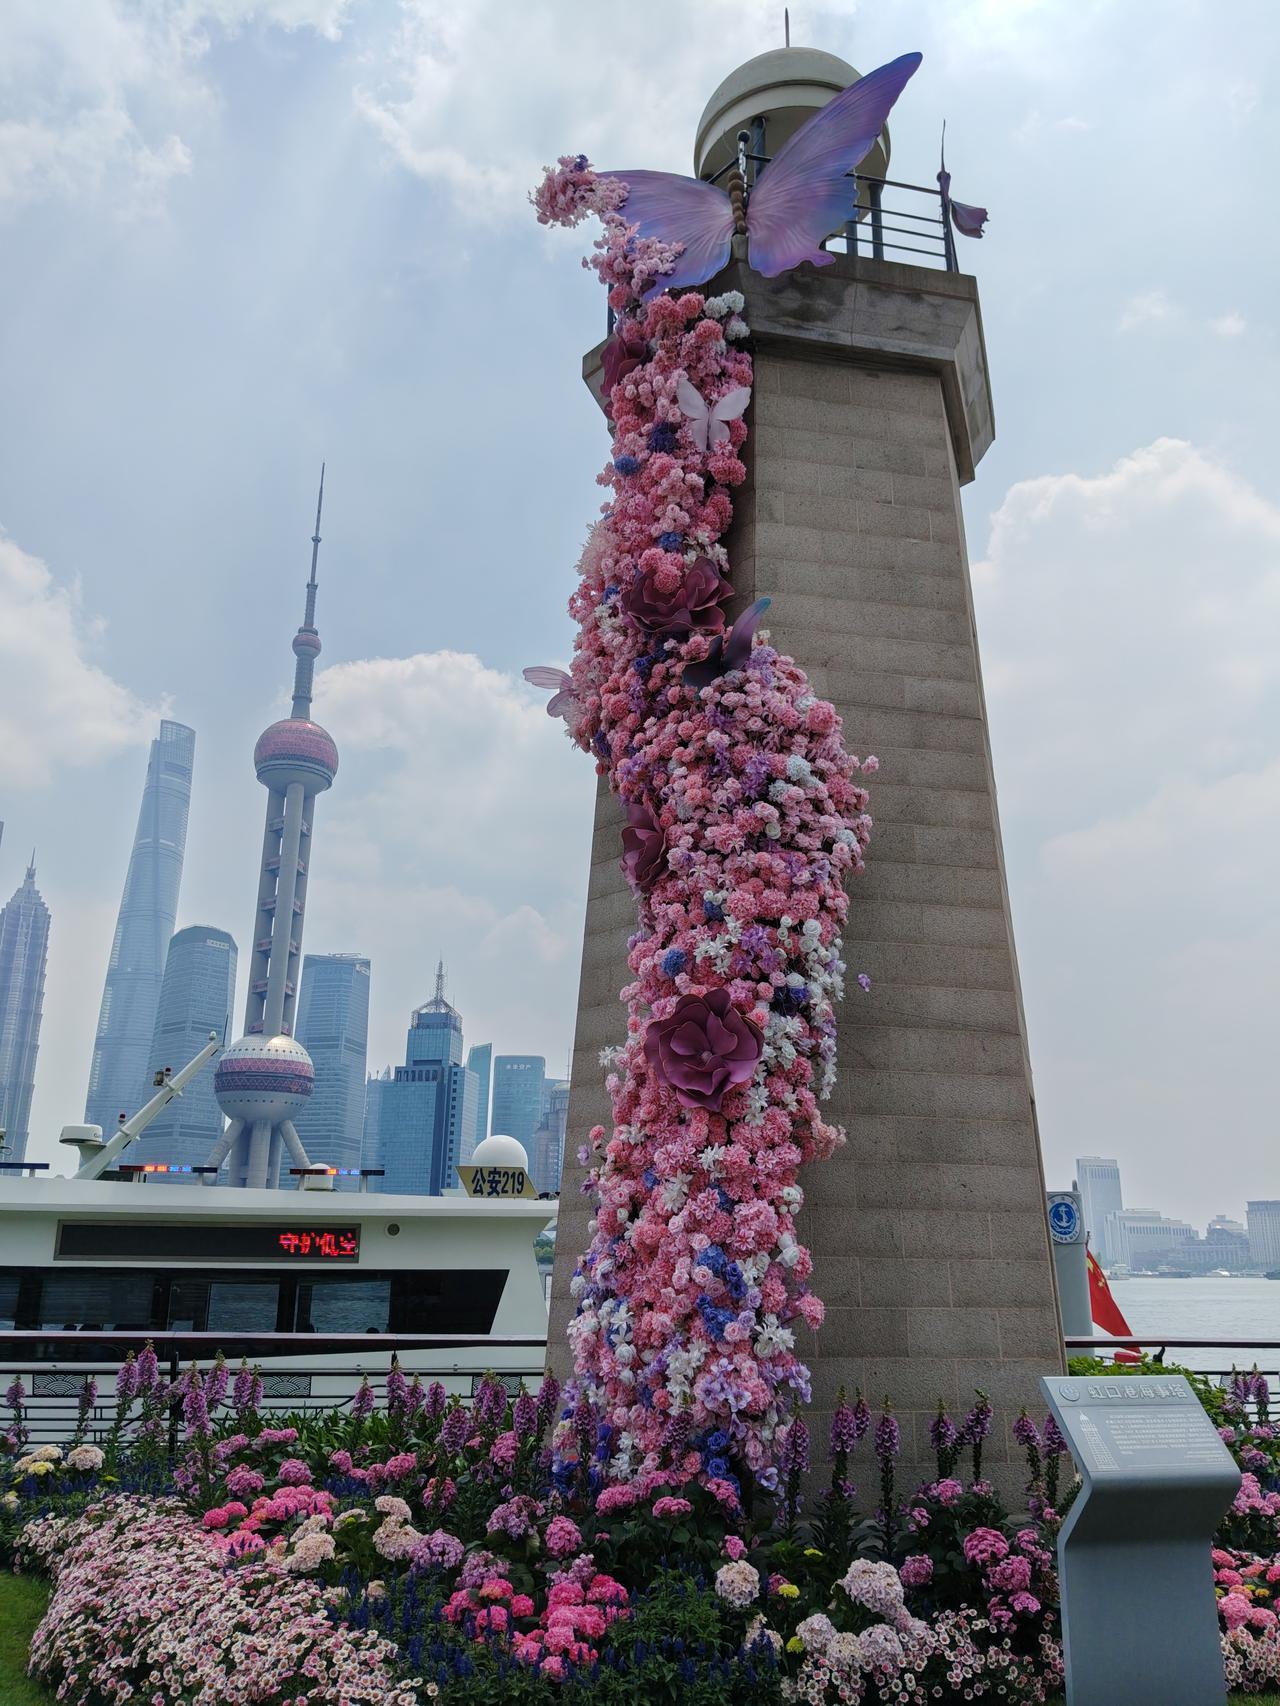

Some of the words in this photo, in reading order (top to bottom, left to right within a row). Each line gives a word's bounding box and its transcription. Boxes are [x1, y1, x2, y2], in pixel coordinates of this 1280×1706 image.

[472, 1167, 524, 1197] 公安219
[1087, 1383, 1188, 1399] 虹口港海事塔
